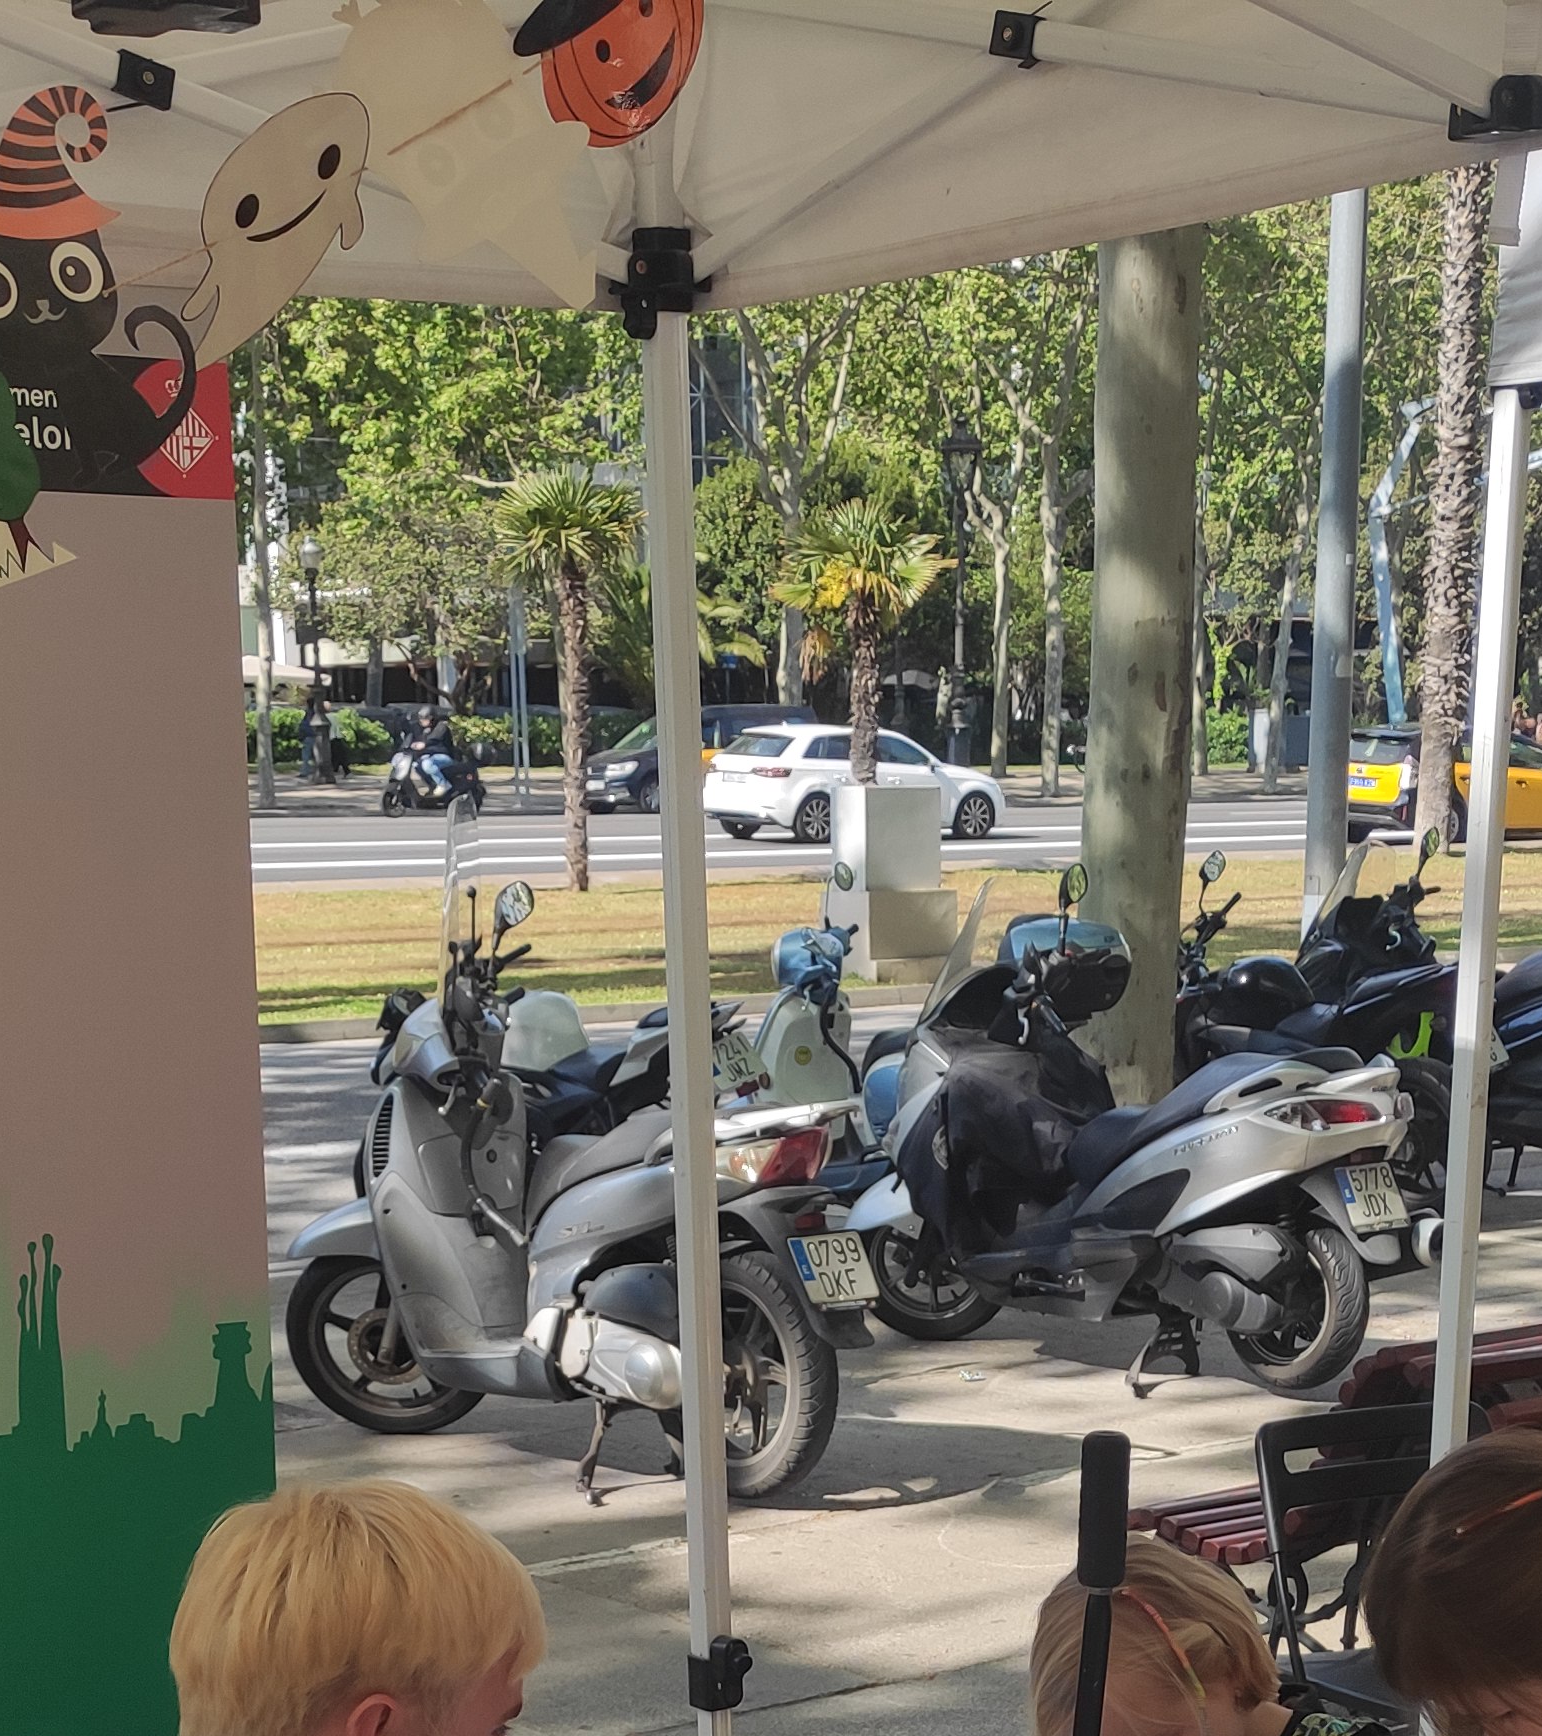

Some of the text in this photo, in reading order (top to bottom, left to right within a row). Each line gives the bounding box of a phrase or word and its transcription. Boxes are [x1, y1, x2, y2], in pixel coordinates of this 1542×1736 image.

[727, 1057, 756, 1083] JMZ
[1349, 1166, 1393, 1193] 5778
[1363, 1191, 1393, 1218] JDX
[806, 1237, 861, 1268] 0799
[819, 1268, 857, 1298] DKF
